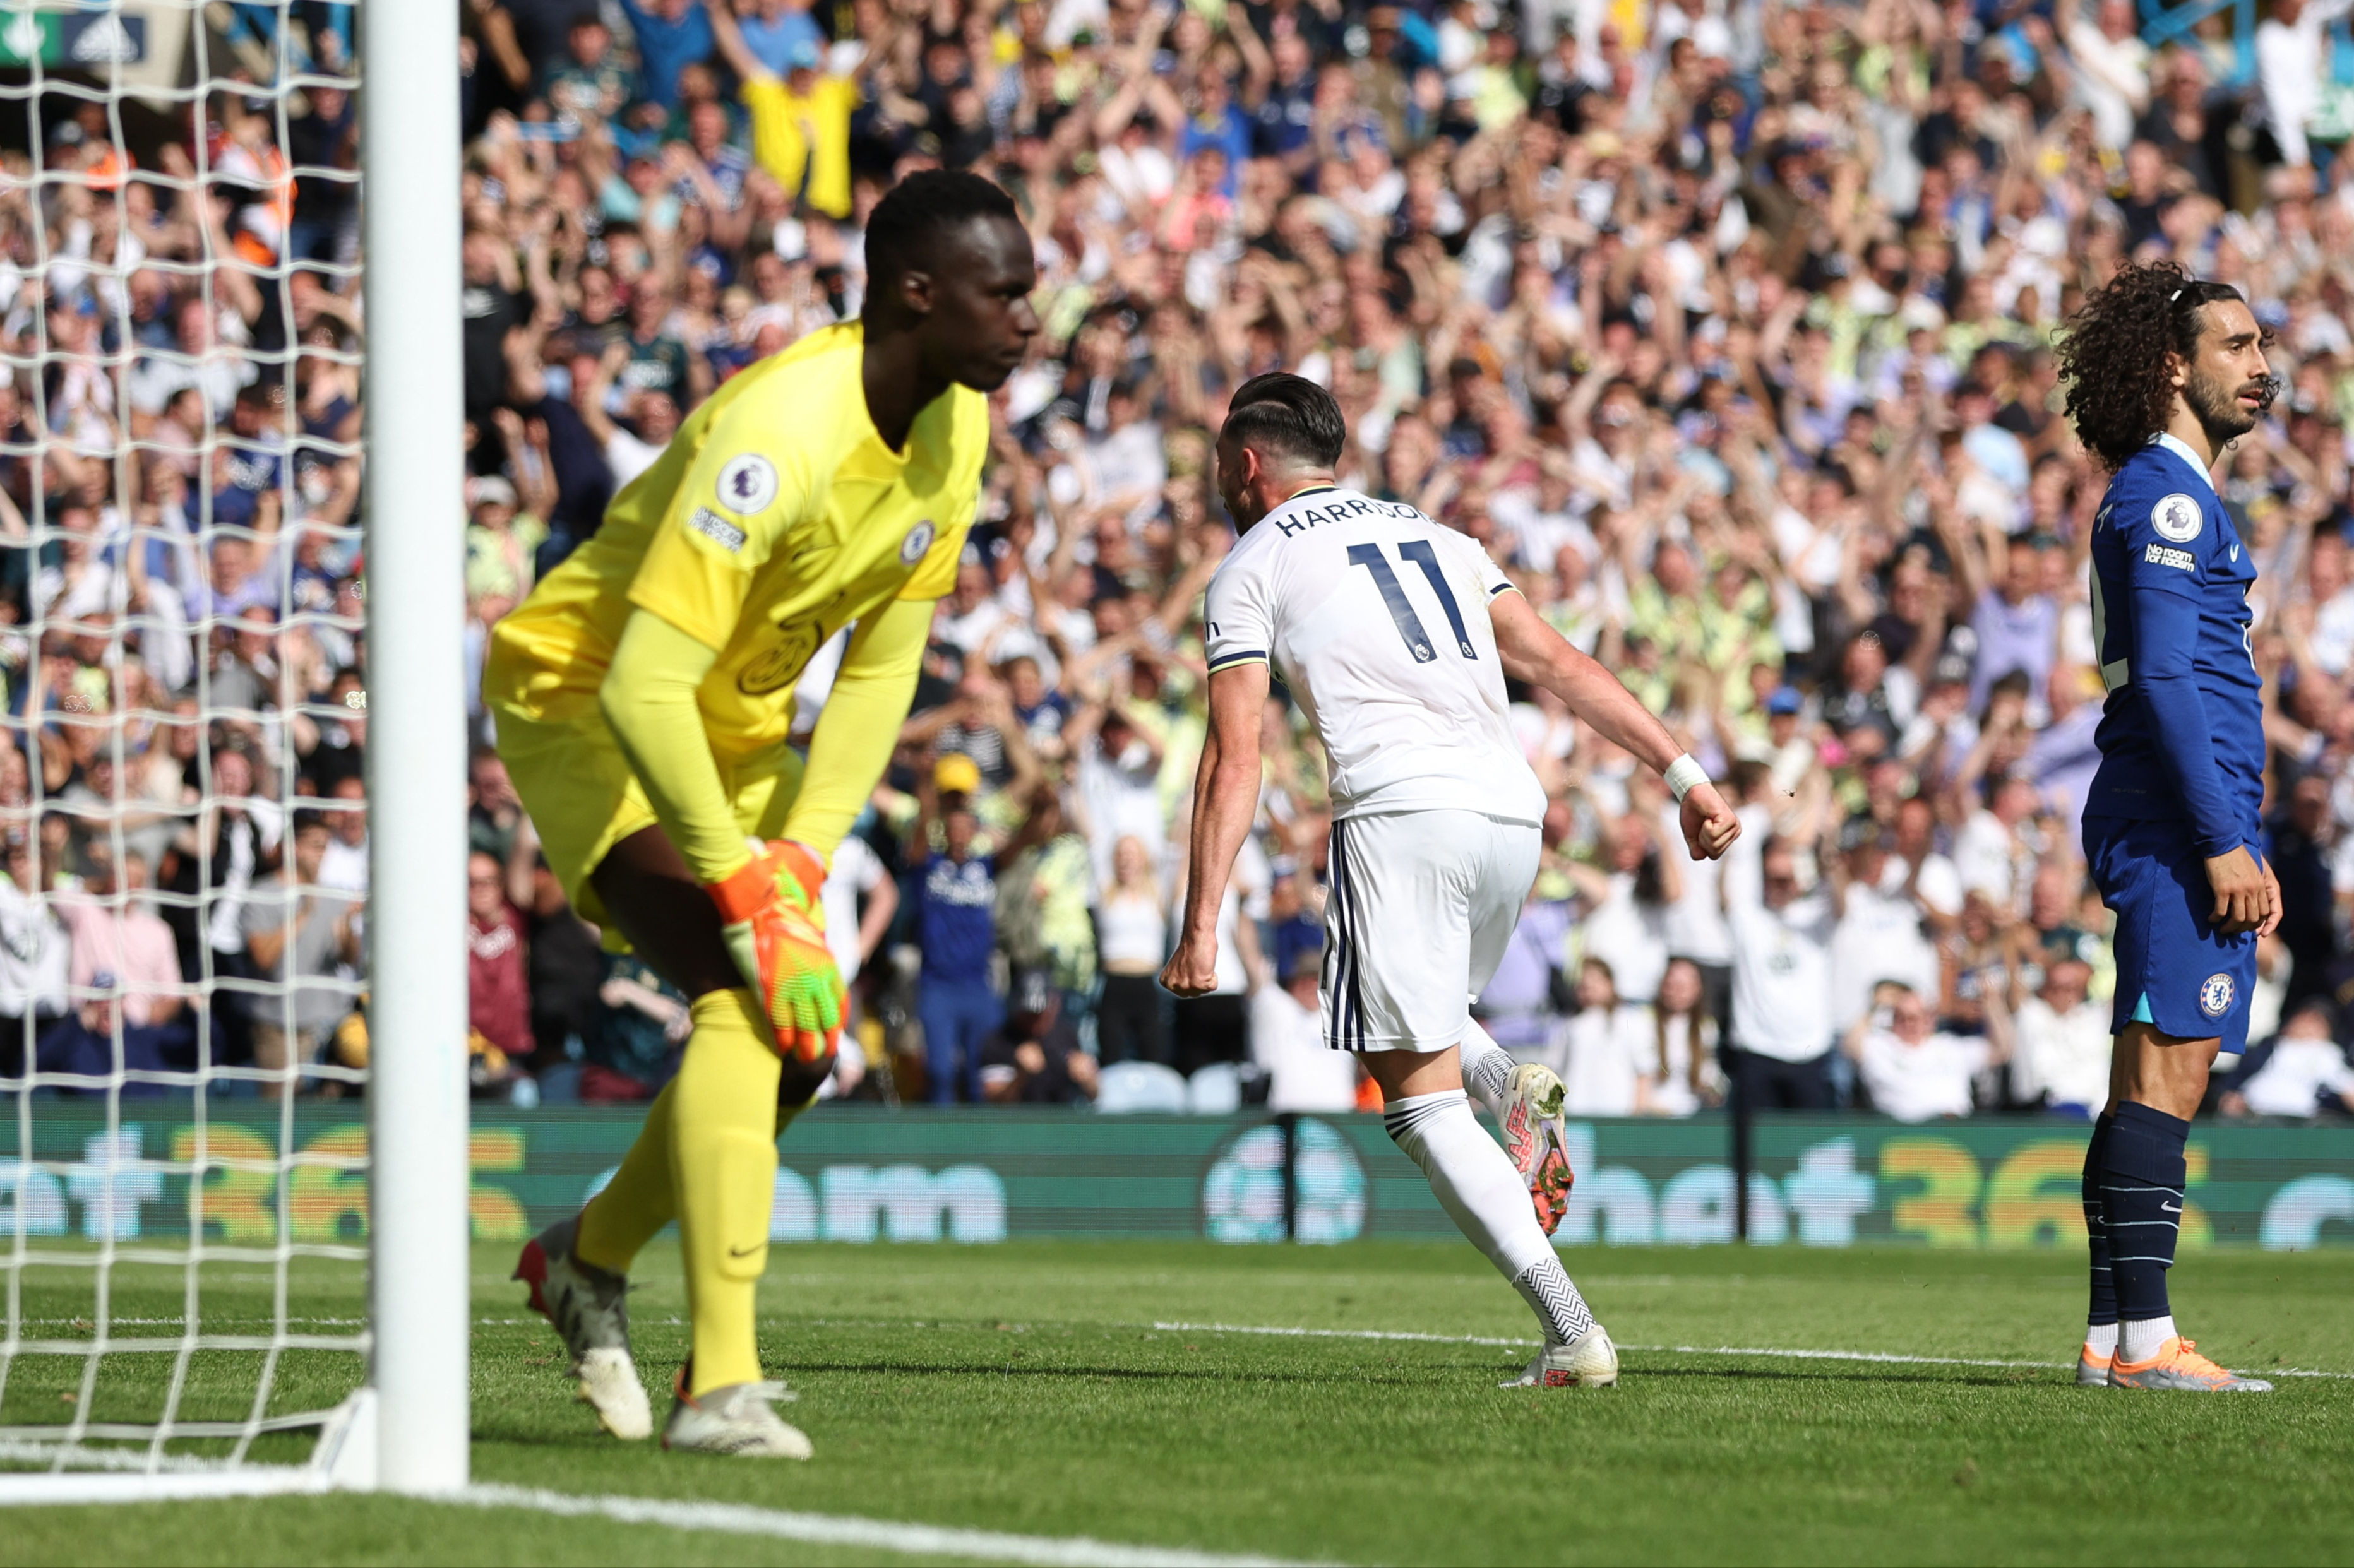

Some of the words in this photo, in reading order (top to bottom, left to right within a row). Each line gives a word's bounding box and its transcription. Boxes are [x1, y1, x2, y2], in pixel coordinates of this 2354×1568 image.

[2144, 552, 2161, 564] for
[2161, 556, 2195, 573] racism
[2146, 543, 2163, 555] No
[2163, 547, 2193, 562] room
[1346, 540, 1479, 664] 11
[2208, 975, 2232, 985] CHELSEA
